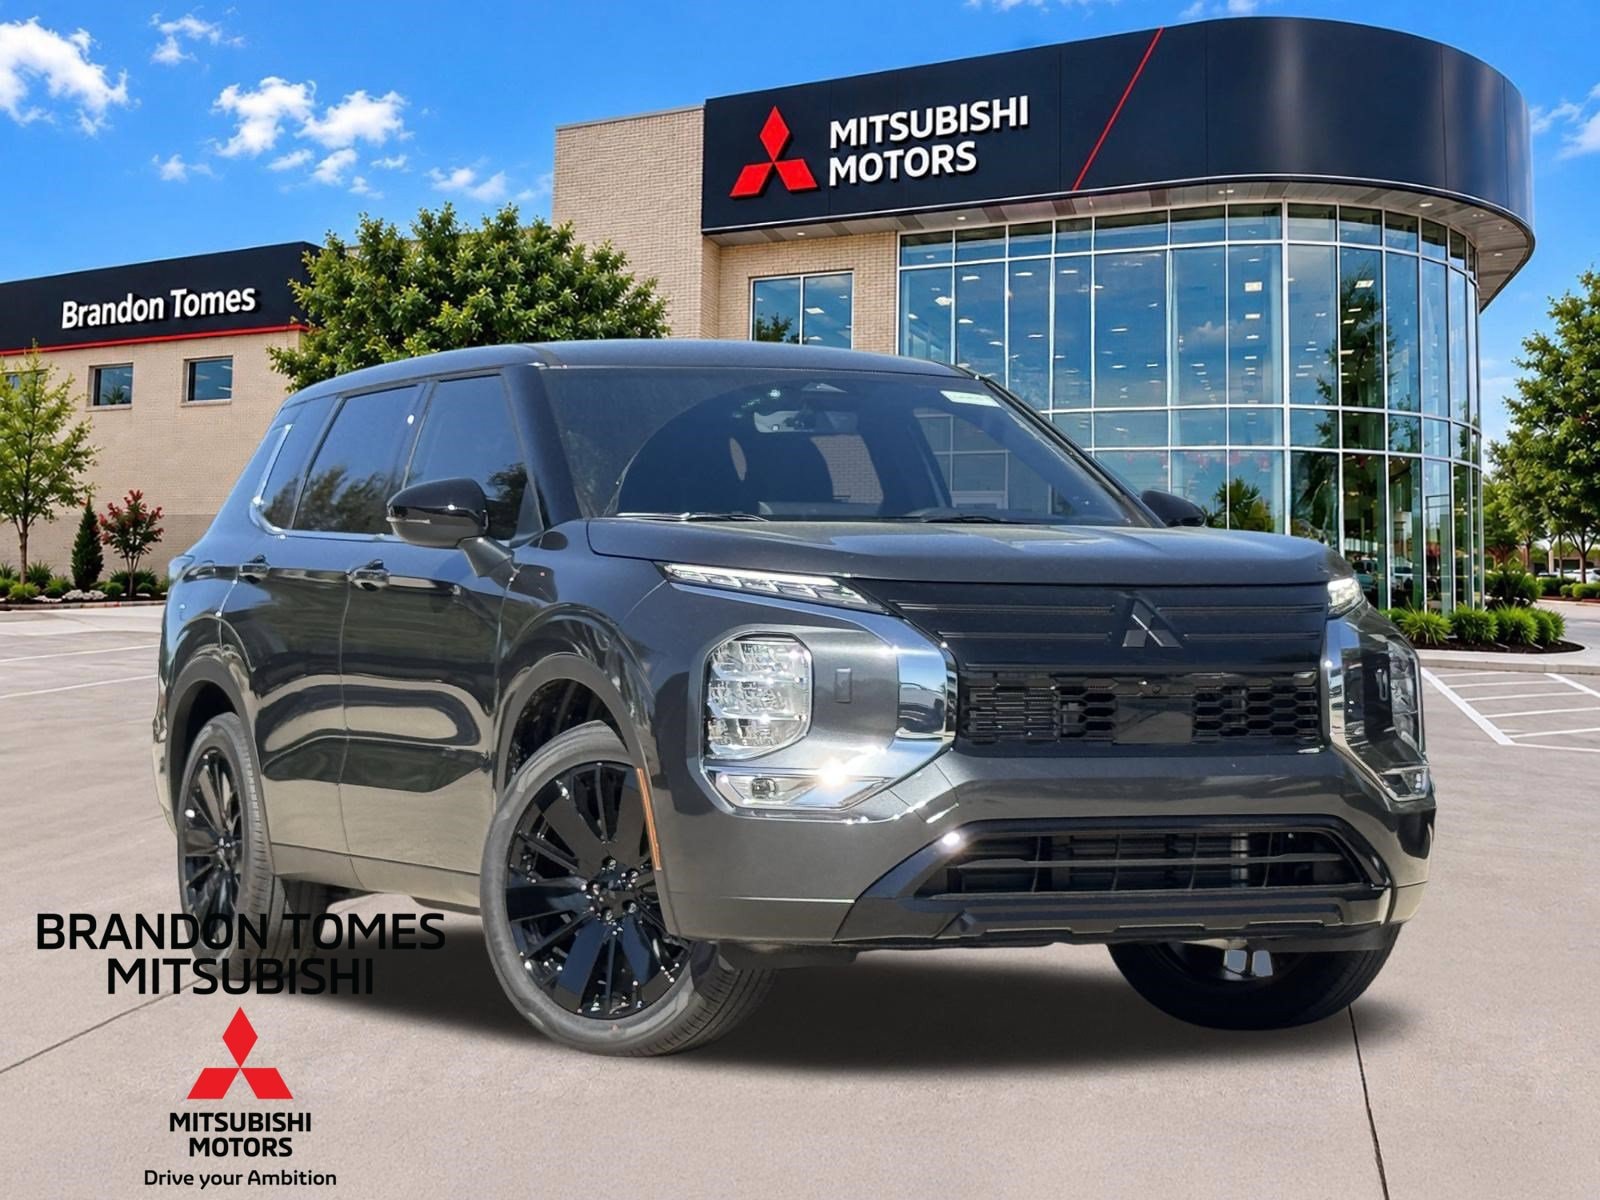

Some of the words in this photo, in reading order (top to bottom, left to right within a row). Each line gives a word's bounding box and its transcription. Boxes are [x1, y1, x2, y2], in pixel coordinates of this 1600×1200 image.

[829, 95, 1028, 149] MITSUBISHI
[829, 141, 977, 186] MOTORS
[61, 293, 165, 329] Brandon
[170, 287, 257, 318] Tomes
